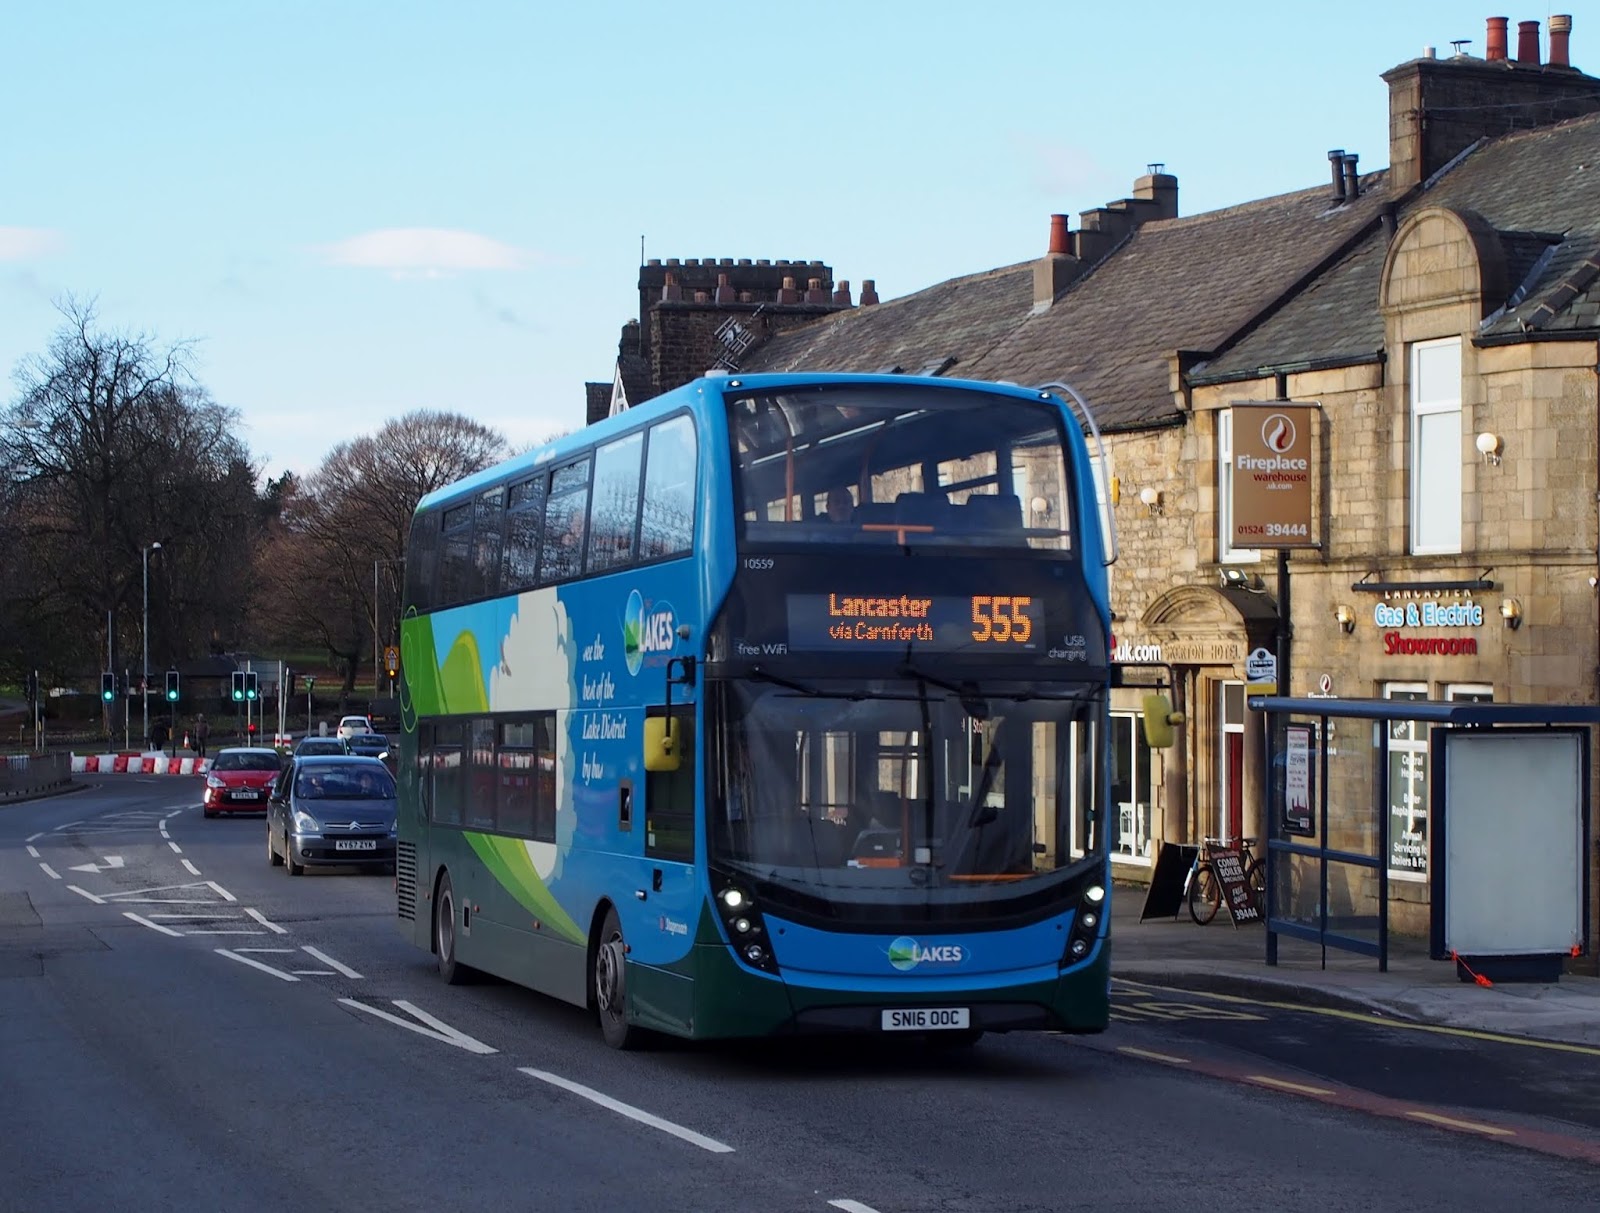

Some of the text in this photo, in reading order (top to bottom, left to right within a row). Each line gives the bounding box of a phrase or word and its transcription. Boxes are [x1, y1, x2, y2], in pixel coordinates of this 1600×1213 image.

[1237, 454, 1307, 473] Fireplace
[1253, 472, 1307, 482] warehouse
[1238, 523, 1308, 536] 01524 39444
[744, 558, 774, 570] 10559
[829, 593, 1032, 643] Lancaster 555
[1375, 600, 1483, 627] Gas & Electric
[638, 608, 673, 652] LAKES
[829, 621, 934, 642] via Carnforth
[593, 634, 604, 660] the
[738, 644, 788, 656] free WiFi
[1064, 634, 1086, 647] USB
[1384, 631, 1478, 656] Showroom
[1048, 646, 1087, 662] charging
[583, 674, 596, 701] best
[603, 671, 614, 700] the
[582, 713, 627, 740] Lake District
[582, 751, 591, 786] by
[1217, 857, 1240, 867] COMBI
[1220, 867, 1243, 876] BOILER
[1235, 908, 1257, 920] 39444
[912, 943, 962, 962] LAKES
[891, 1010, 960, 1026] SN16 OOC
